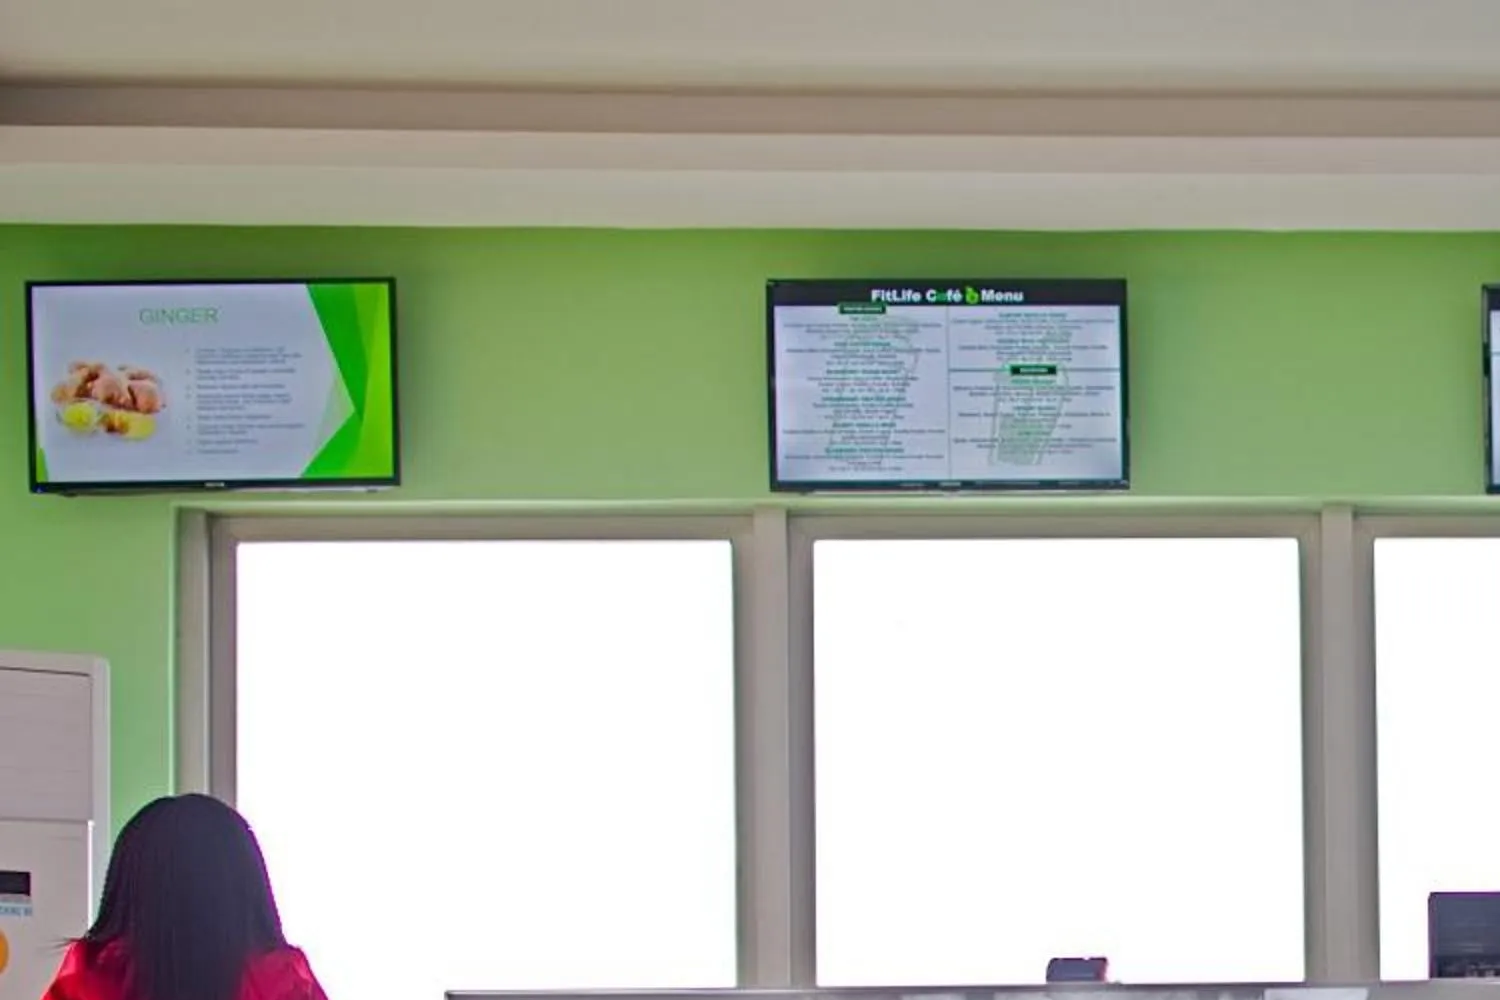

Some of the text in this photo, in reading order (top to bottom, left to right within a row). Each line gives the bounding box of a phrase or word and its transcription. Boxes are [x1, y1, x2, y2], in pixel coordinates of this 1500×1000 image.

[872, 289, 922, 302] FitLife
[981, 289, 1024, 302] Menu
[139, 307, 219, 325] GINGER
